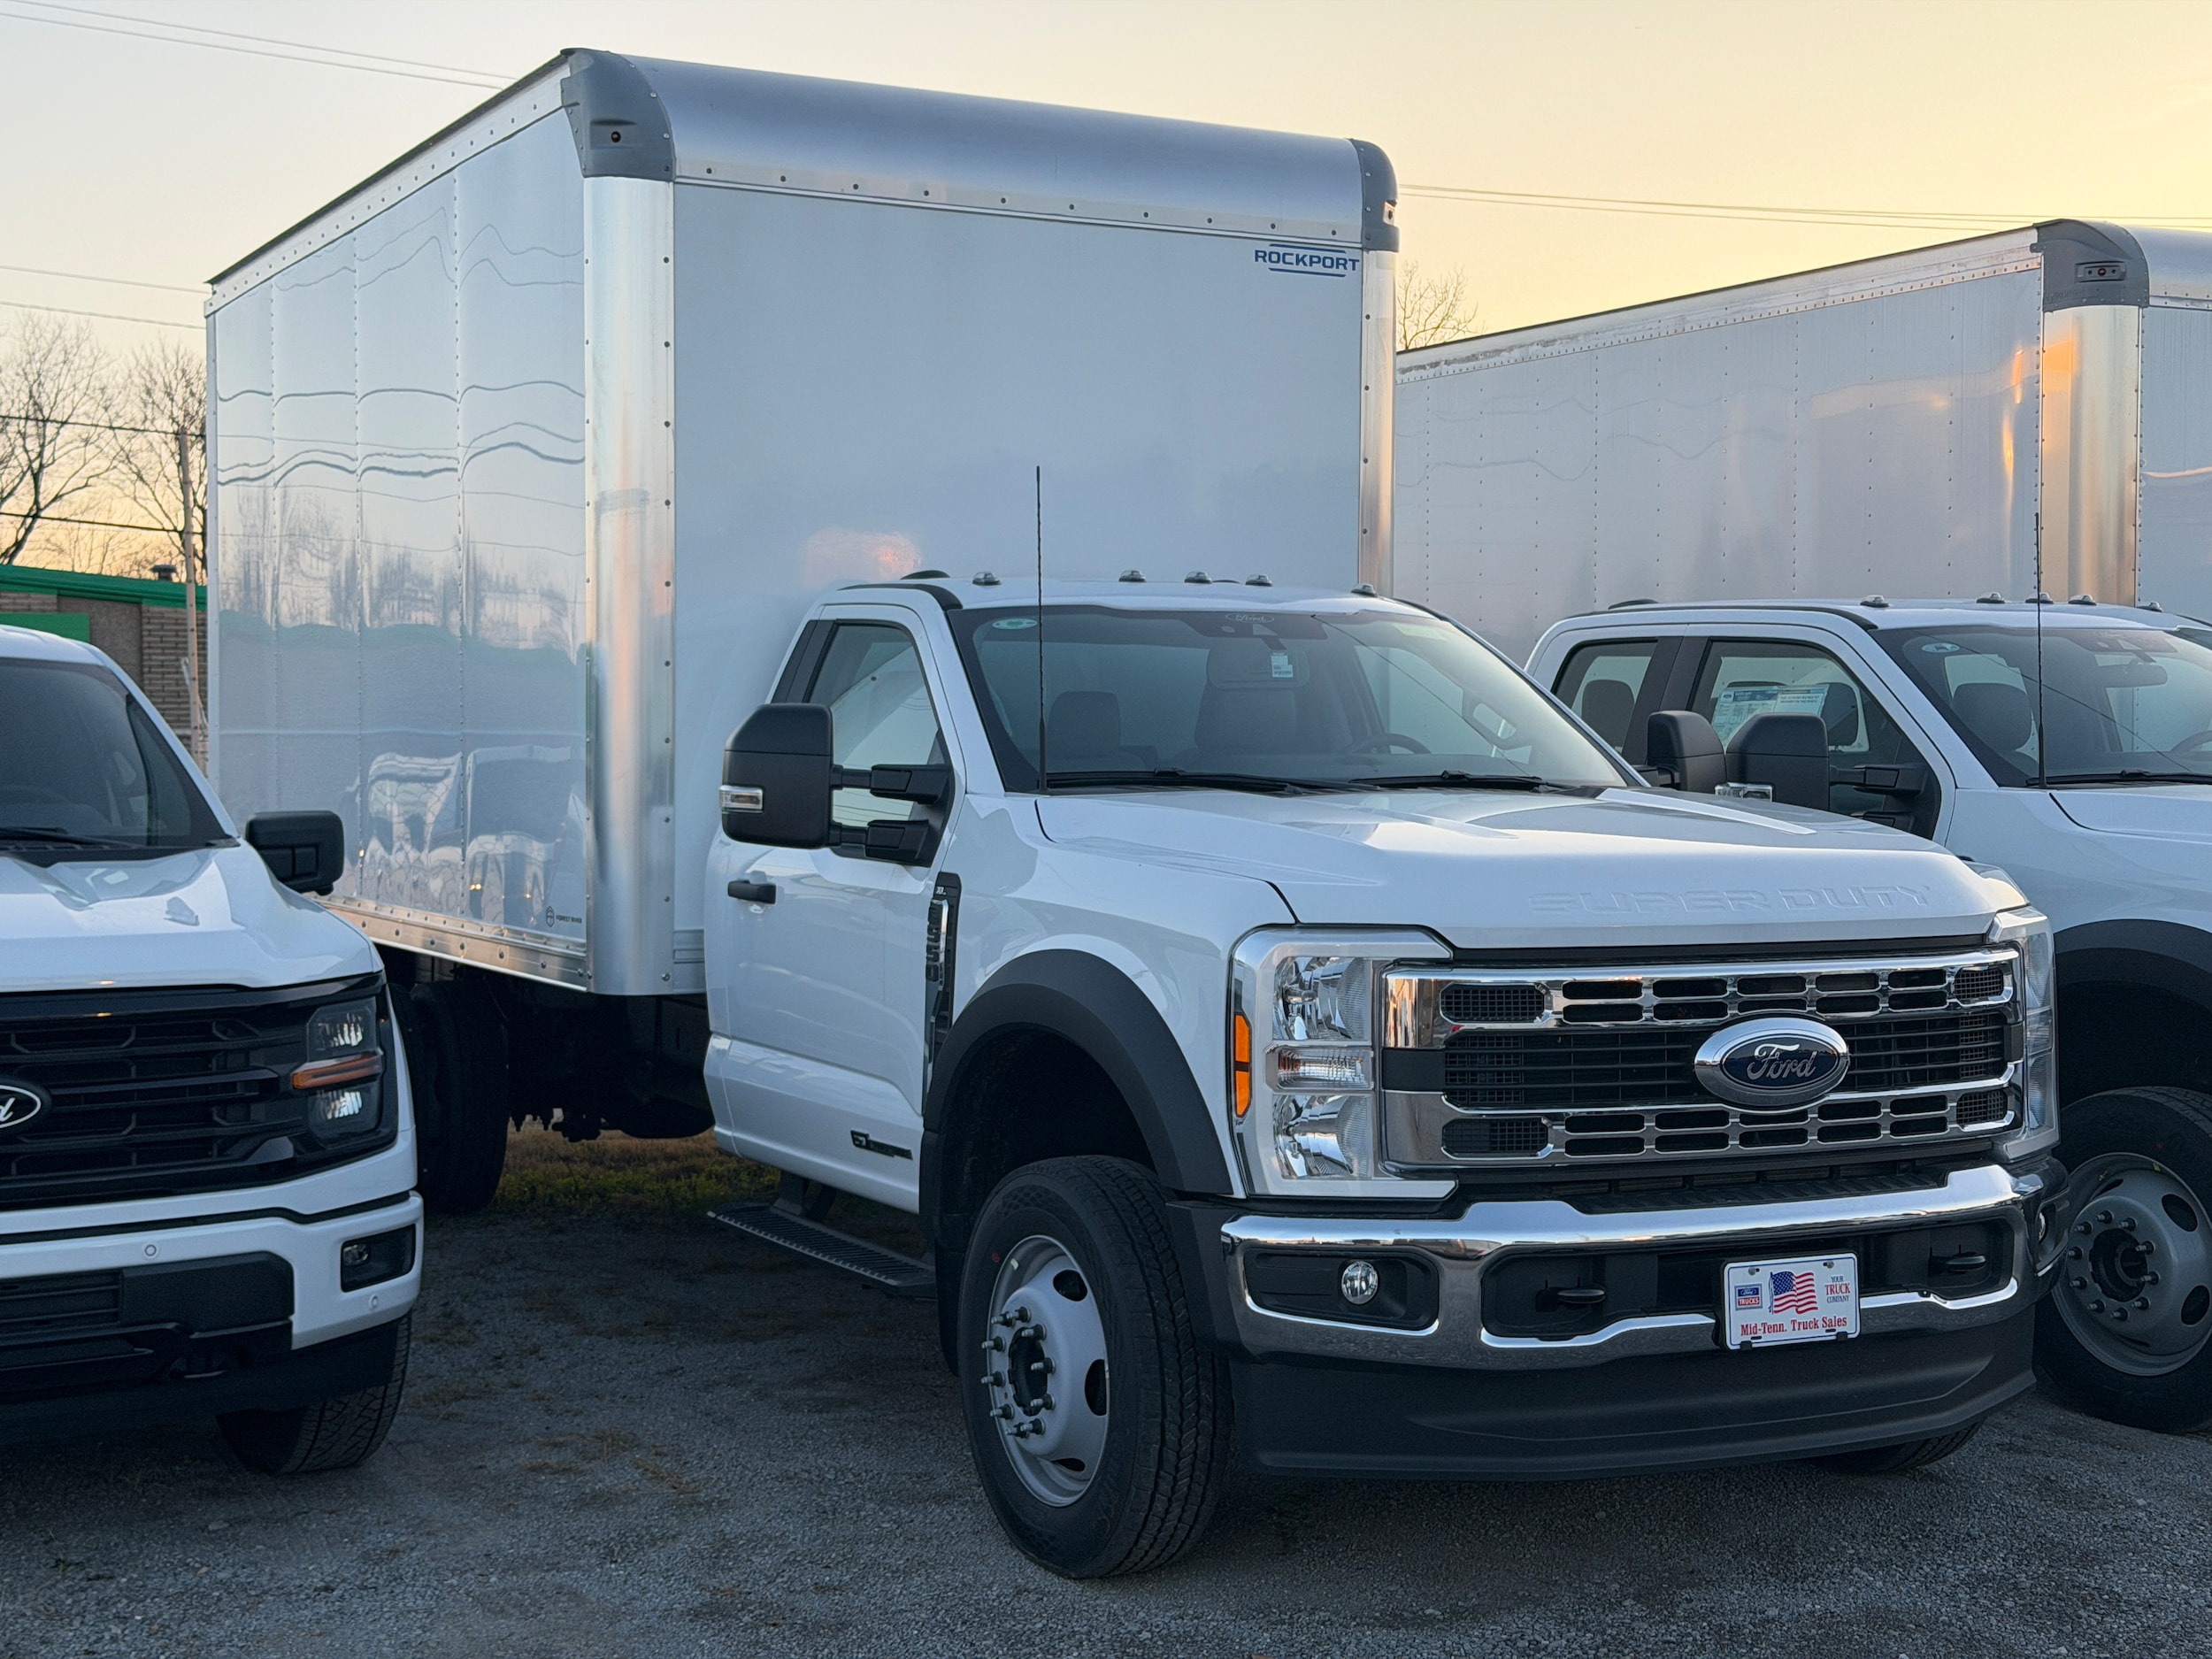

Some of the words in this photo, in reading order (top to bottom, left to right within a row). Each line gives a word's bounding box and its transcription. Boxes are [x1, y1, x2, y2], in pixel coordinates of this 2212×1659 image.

[1255, 250, 1360, 271] ROCKPORT
[1529, 890, 1770, 914] SUPER
[1777, 885, 1931, 911] DUTY
[1747, 1043, 1818, 1079] Ford
[1824, 1283, 1851, 1295] TRUCK
[1826, 1294, 1849, 1303] COMPANY
[1740, 1322, 1787, 1336] Mid-Tenn.
[1790, 1317, 1819, 1331] Truck
[1822, 1316, 1847, 1328] Sales
